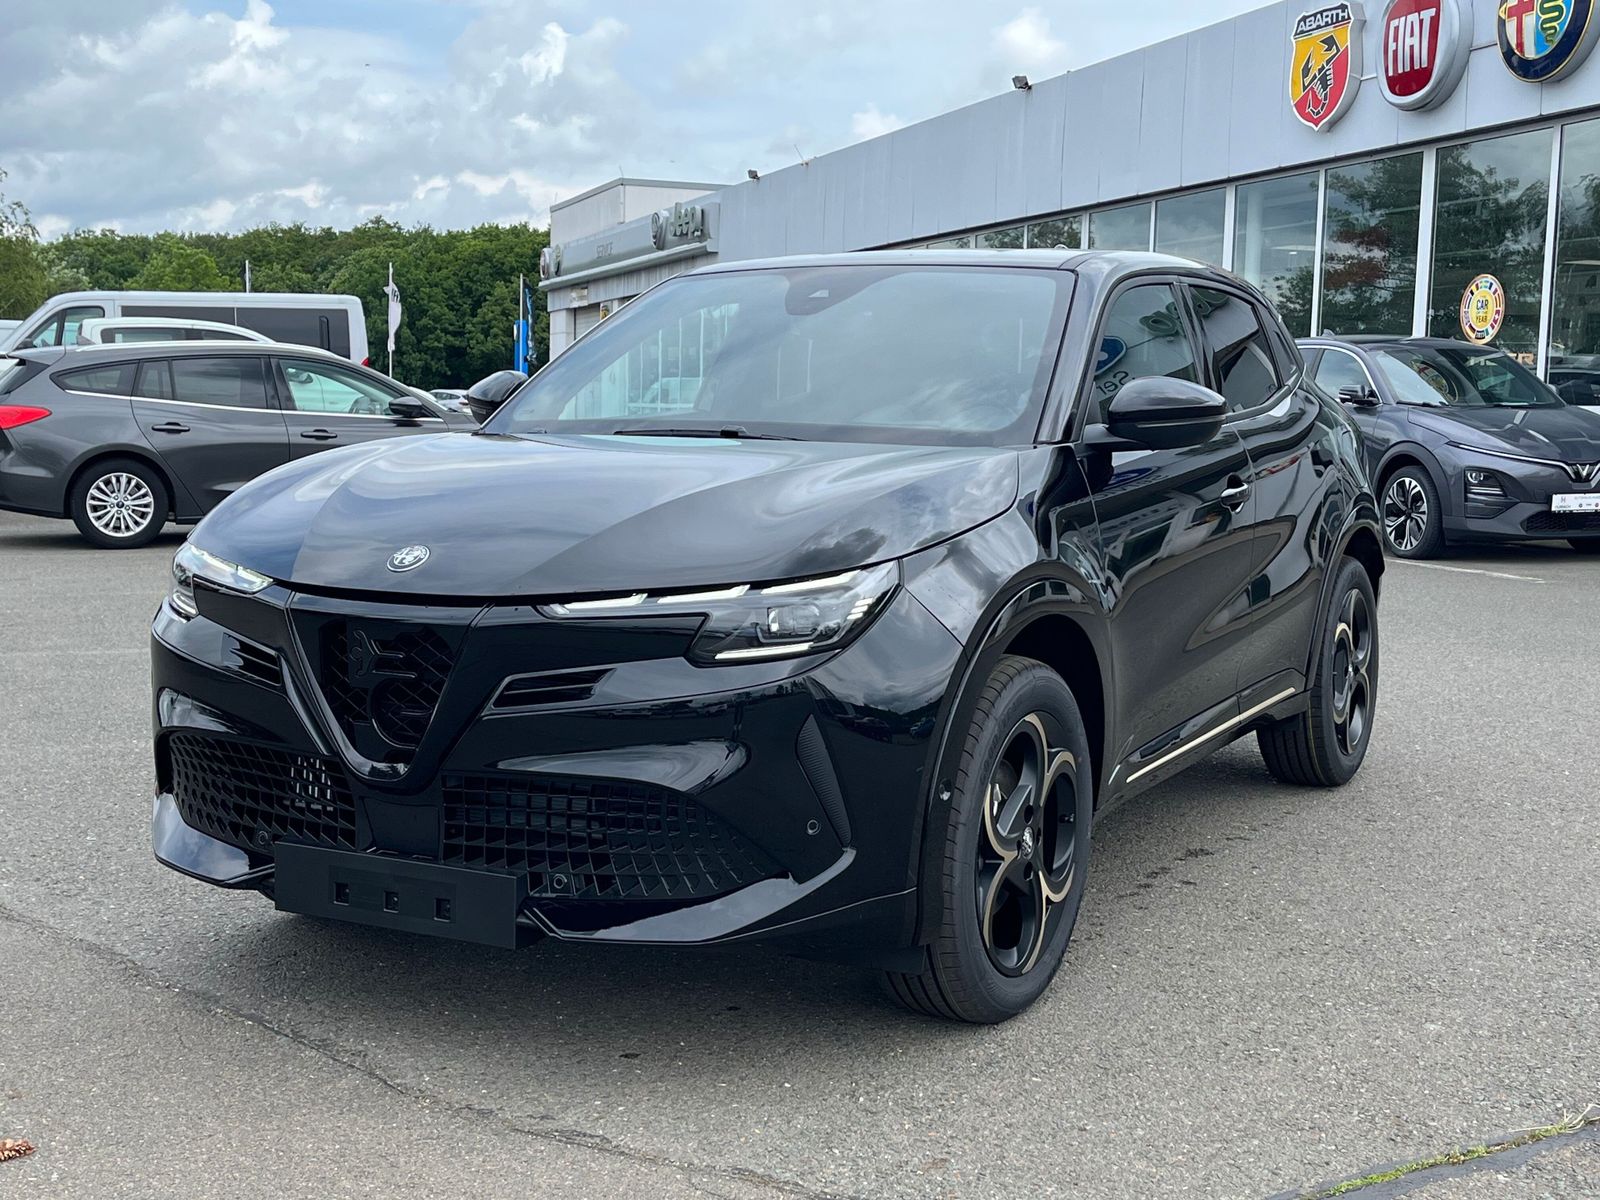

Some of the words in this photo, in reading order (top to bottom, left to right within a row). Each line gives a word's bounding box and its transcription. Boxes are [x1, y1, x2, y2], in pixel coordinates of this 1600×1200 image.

[1296, 8, 1349, 33] ABARTH
[1387, 7, 1437, 77] FIAT
[670, 202, 700, 239] Jeep
[1476, 299, 1489, 310] CAR
[1475, 315, 1488, 323] YEAR
